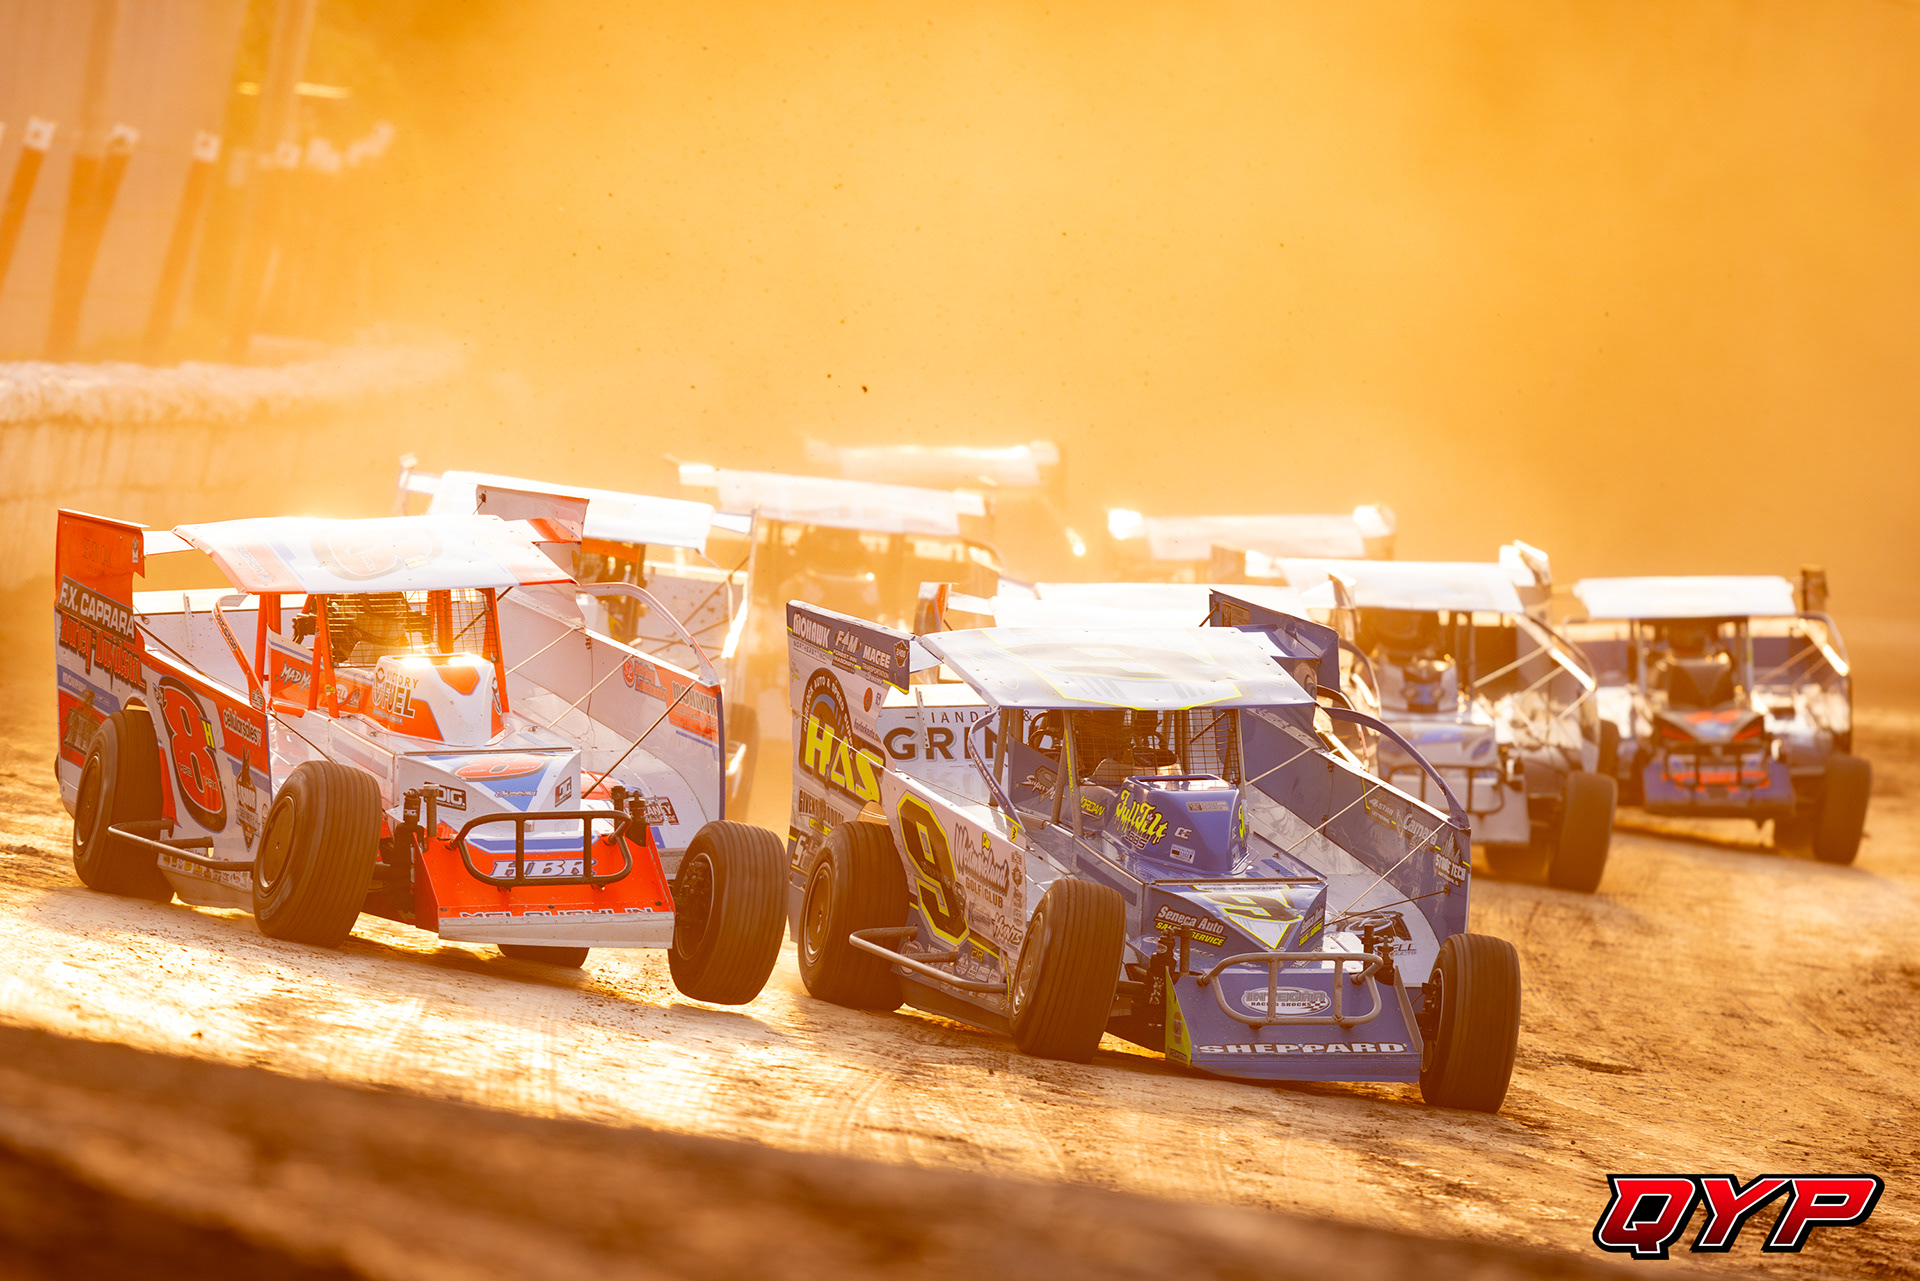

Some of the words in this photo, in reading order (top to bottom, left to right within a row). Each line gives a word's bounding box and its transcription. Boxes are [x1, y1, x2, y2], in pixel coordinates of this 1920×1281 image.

[60, 582, 78, 611] F.X.
[80, 593, 135, 639] CAPRARA
[793, 614, 831, 648] MOHAWK
[60, 611, 146, 692] Harley-Davidson
[863, 645, 891, 669] MAGEE
[382, 681, 416, 718] FUEL
[672, 680, 718, 718] MOHAWK
[814, 676, 826, 689] AUTO
[826, 678, 831, 689] &
[831, 682, 844, 711] SPEED
[162, 682, 225, 818] 8
[201, 719, 216, 750] H
[805, 715, 884, 803] HAS
[897, 791, 970, 948] 9
[966, 877, 982, 896] GOLF
[984, 888, 1004, 909] CLUB
[1158, 906, 1197, 927] Seneca
[1198, 918, 1224, 934] Auto
[1191, 931, 1225, 947] SERVICE
[1198, 1042, 1408, 1054] SHEPPARD
